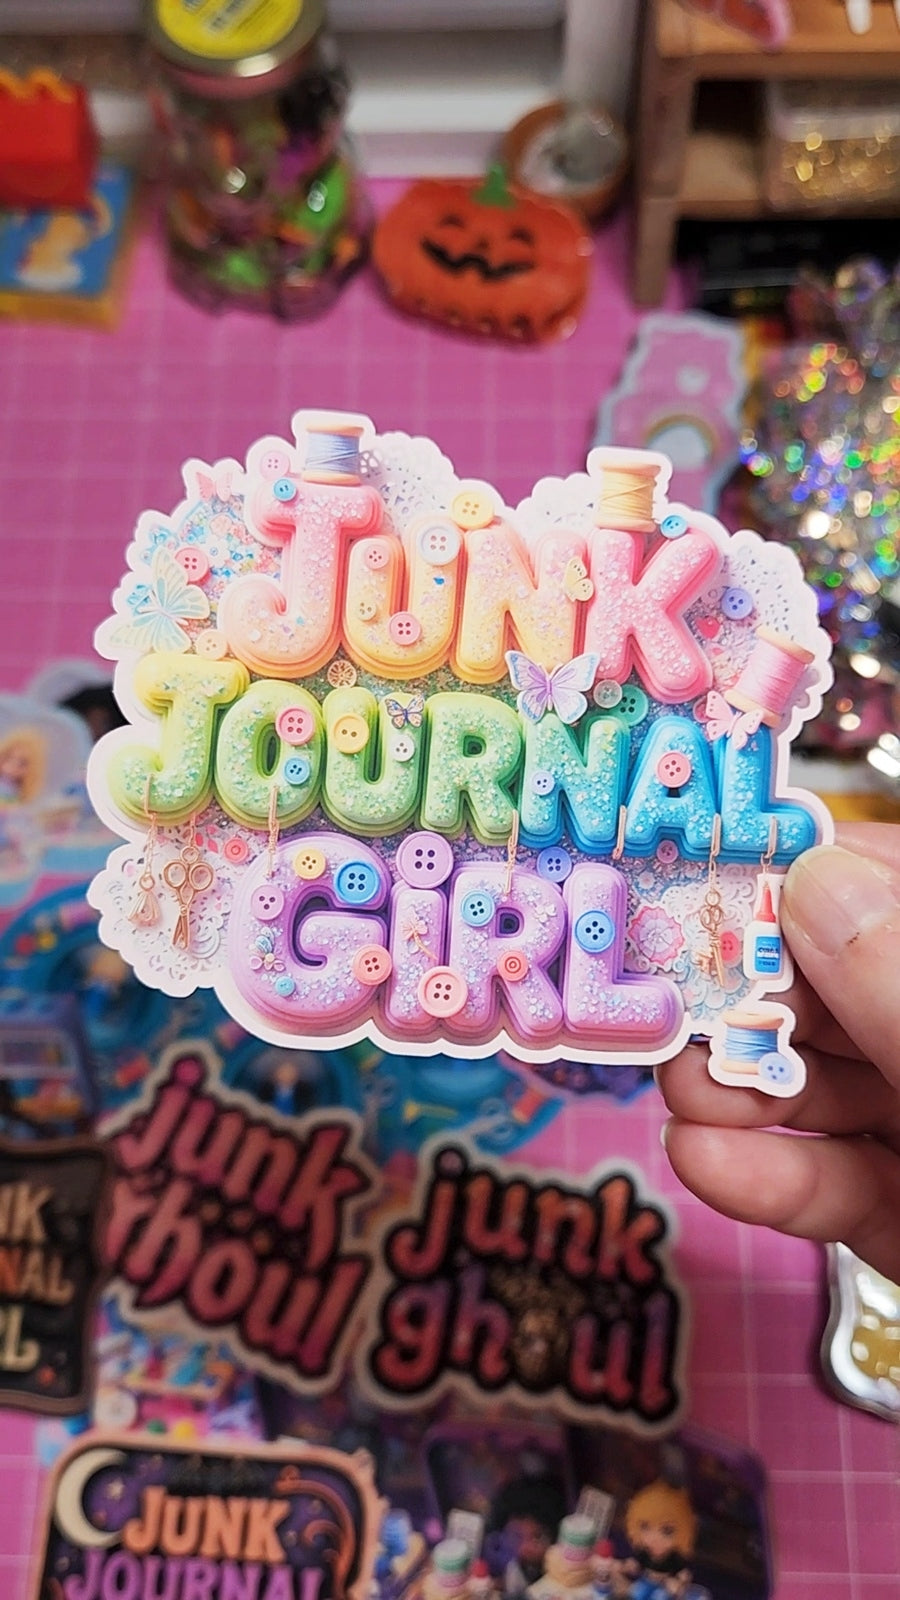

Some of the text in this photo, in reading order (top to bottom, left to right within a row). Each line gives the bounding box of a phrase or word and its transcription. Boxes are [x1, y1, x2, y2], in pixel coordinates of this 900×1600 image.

[219, 478, 724, 705] JUNK
[106, 652, 820, 864] JOURNAL
[390, 1150, 663, 1283] junk
[376, 1262, 672, 1412] ghul
[122, 1484, 292, 1563] JUNK
